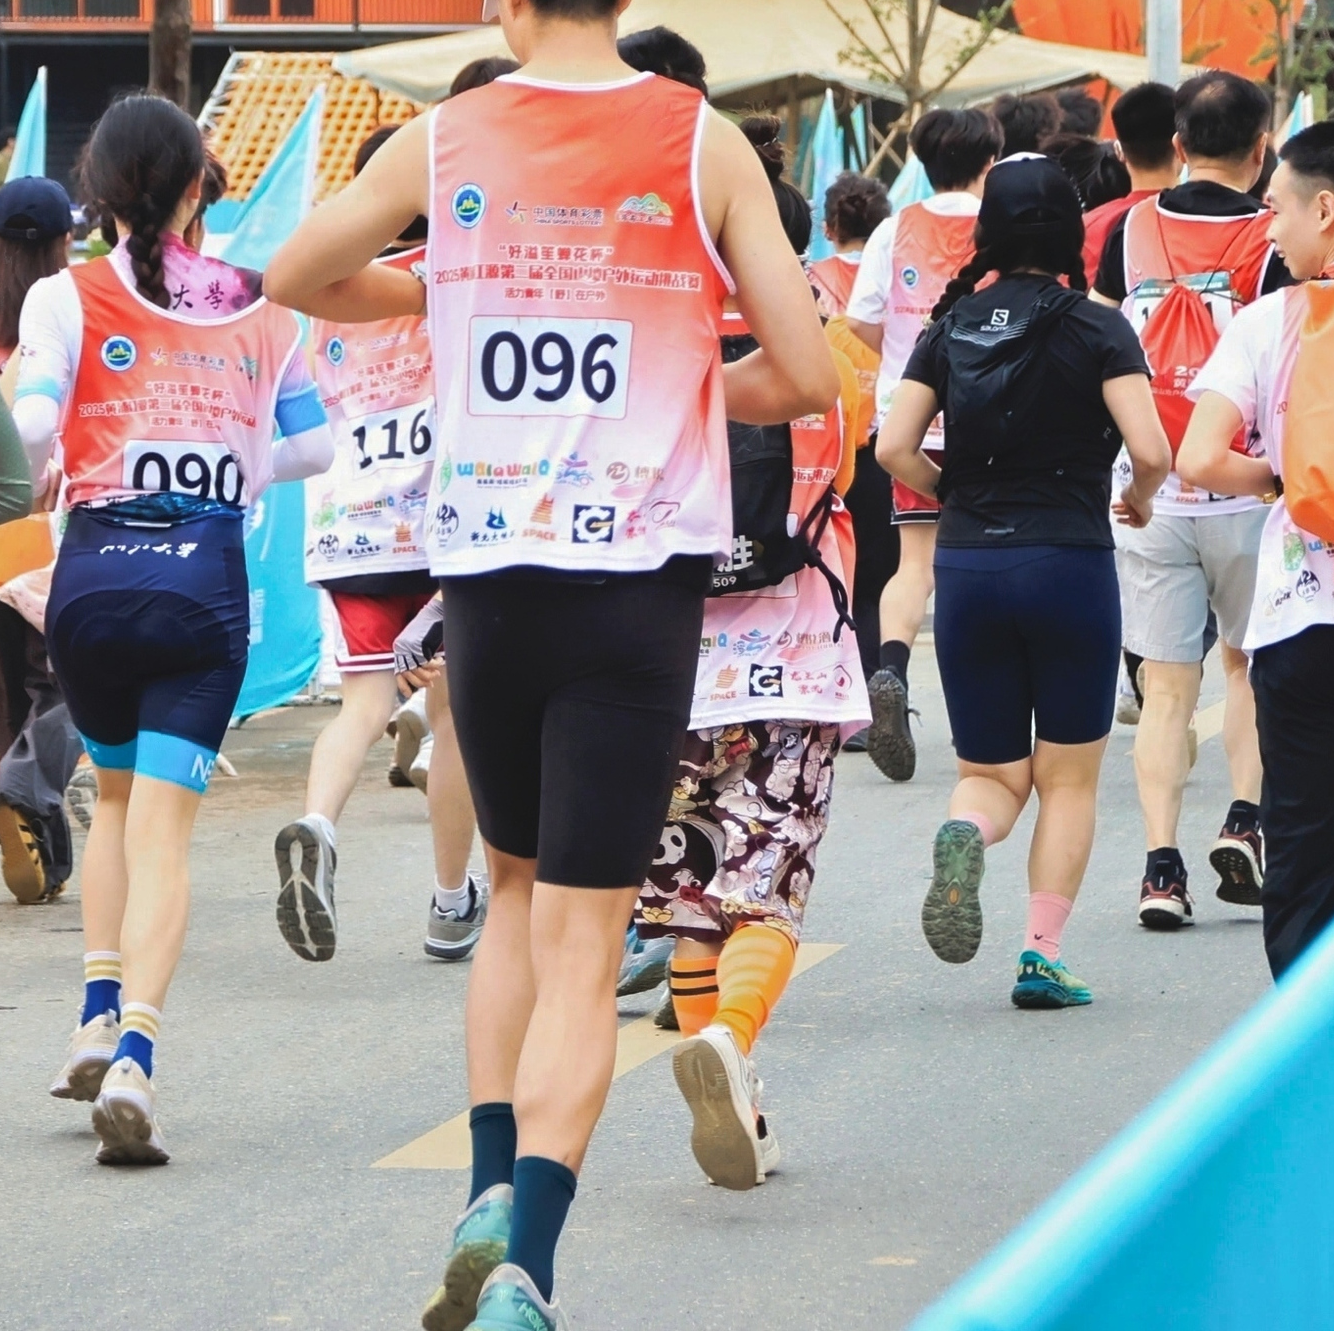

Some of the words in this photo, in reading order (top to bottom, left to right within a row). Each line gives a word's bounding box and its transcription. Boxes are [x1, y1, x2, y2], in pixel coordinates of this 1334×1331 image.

[533, 208, 602, 219] 中国体育彩票
[480, 331, 618, 403] 096
[352, 409, 432, 470] 116
[133, 452, 244, 505] 090
[522, 529, 557, 541] SPACE
[392, 545, 417, 554] SPACE
[713, 576, 737, 588] 509
[710, 691, 737, 701] SPACE
